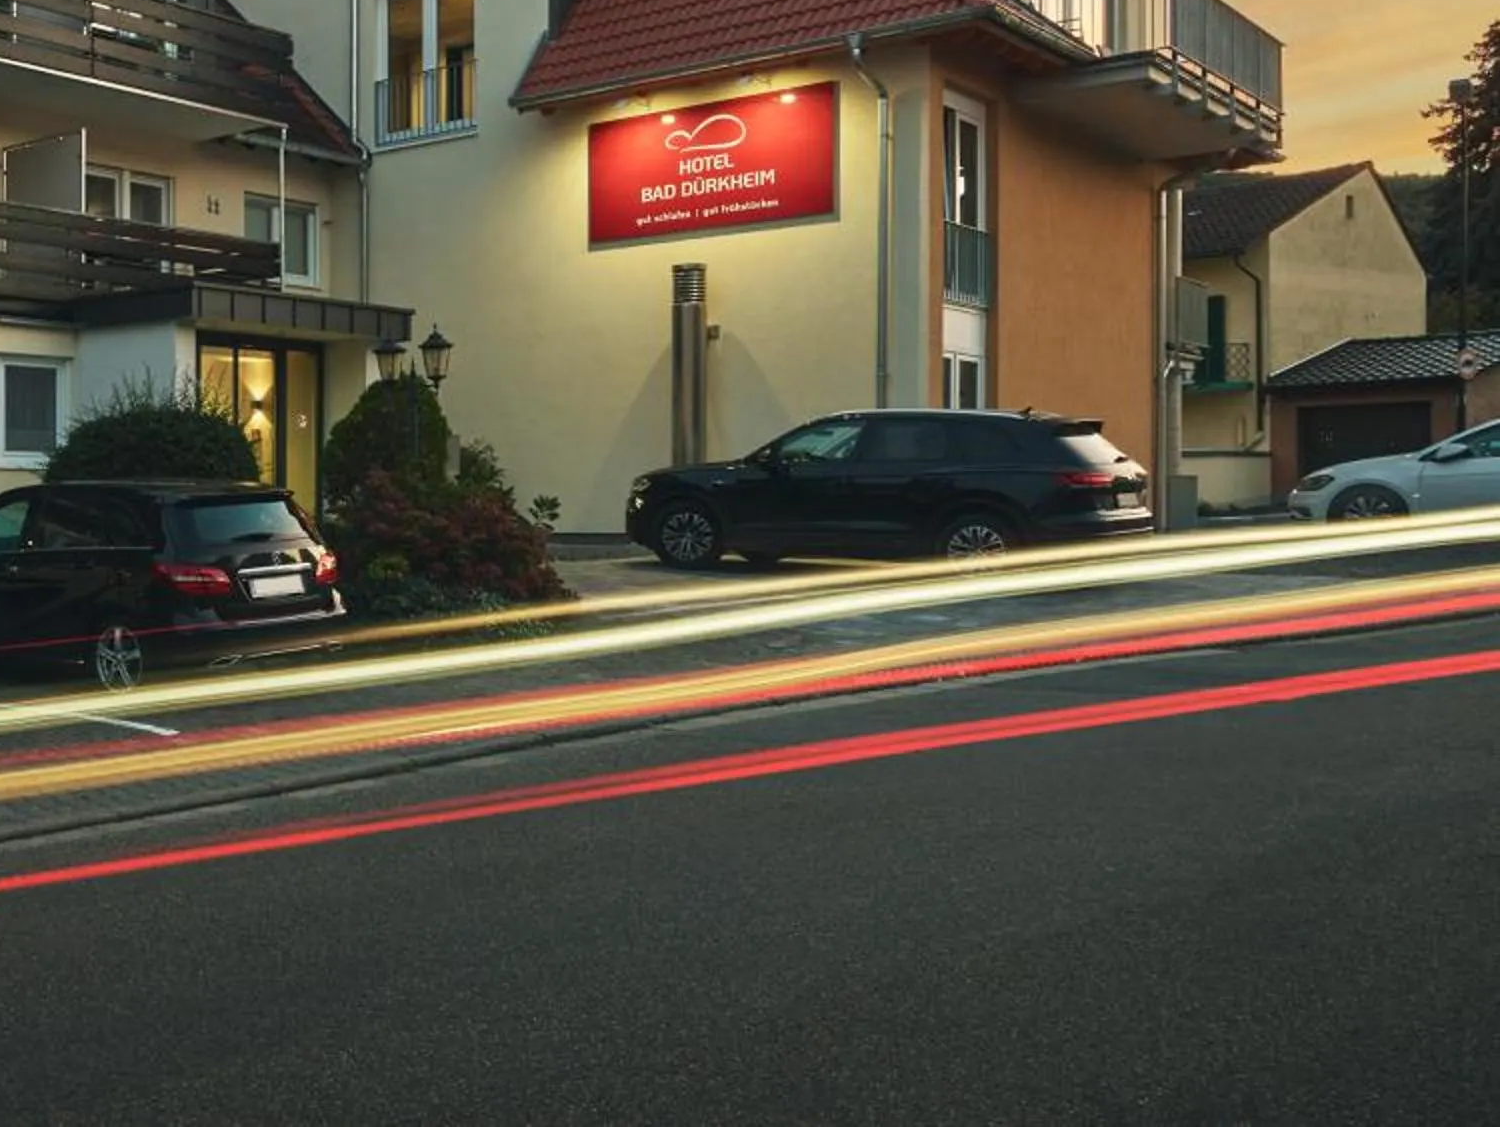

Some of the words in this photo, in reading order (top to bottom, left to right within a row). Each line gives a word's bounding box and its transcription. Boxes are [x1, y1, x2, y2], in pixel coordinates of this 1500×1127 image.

[679, 153, 735, 175] HOTEL
[641, 184, 676, 203] BAD
[681, 168, 775, 198] DÜRKHEIM
[703, 206, 719, 218] gut
